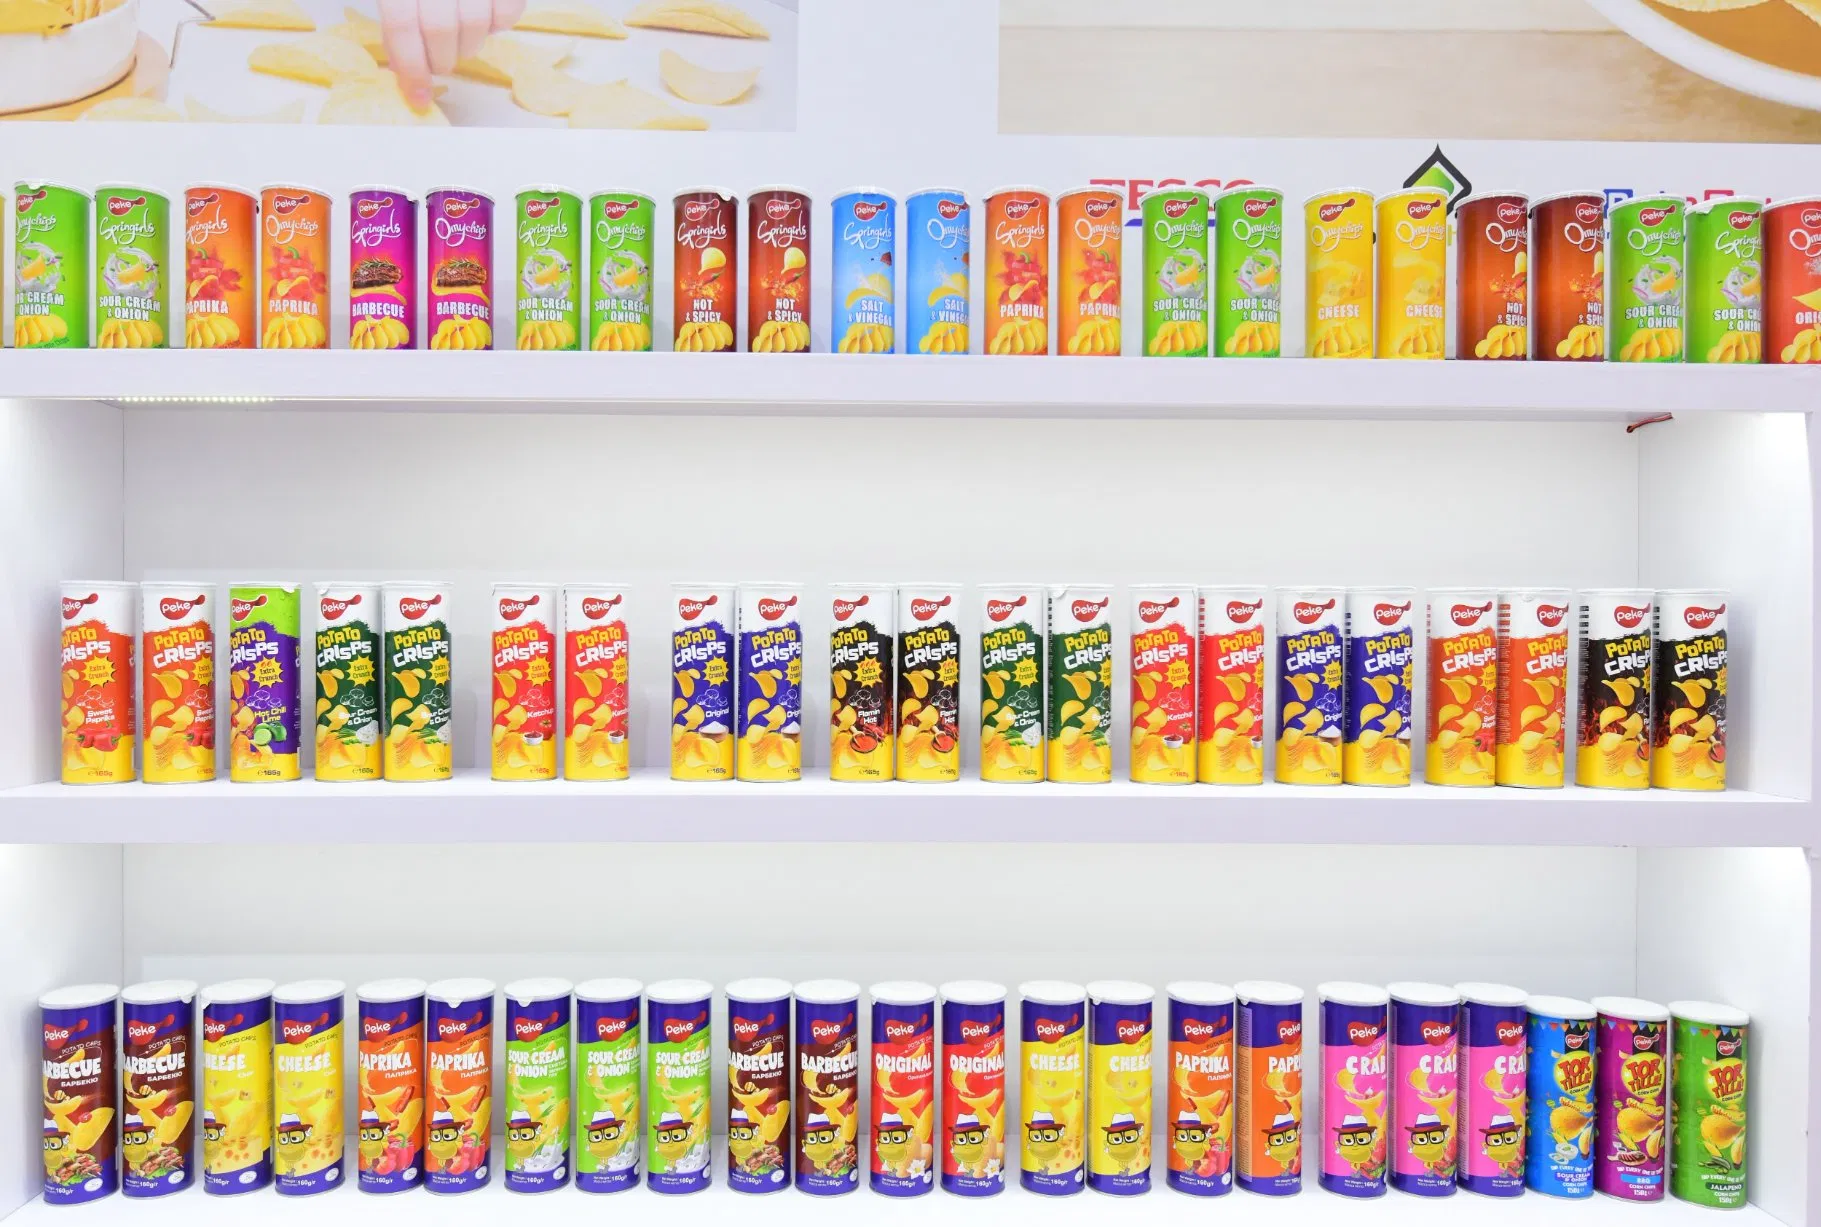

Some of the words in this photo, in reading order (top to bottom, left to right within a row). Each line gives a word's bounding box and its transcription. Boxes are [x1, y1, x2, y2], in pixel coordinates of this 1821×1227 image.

[28, 294, 64, 305] CREAM
[99, 296, 122, 308] SOUR
[125, 298, 161, 312] CREAM
[269, 299, 318, 314] PAPRIKA
[519, 299, 538, 310] SOUR
[542, 299, 573, 312] CREAM
[595, 299, 615, 311] SOUR
[619, 299, 649, 314] CREAM
[694, 299, 712, 310] HOT
[776, 299, 795, 310] HOT
[861, 299, 882, 312] SALT
[944, 299, 964, 311] SALT
[1154, 299, 1179, 311] SOUR
[1231, 299, 1256, 311] SOUR
[19, 305, 49, 316] ONION
[116, 308, 149, 321] ONION
[352, 304, 404, 318] BARBECUE
[437, 302, 489, 319] BARBECUE
[532, 311, 563, 321] ONION
[611, 311, 641, 323] ONION
[692, 311, 721, 323] SPICY
[775, 311, 802, 323] SPICY
[1001, 304, 1044, 318] PAPRIKA
[1173, 310, 1201, 323] ONION
[1251, 310, 1278, 323] ONION
[1318, 306, 1360, 318] CHEESE
[1507, 304, 1522, 314] HOT
[1626, 306, 1655, 319] SOUR
[1714, 310, 1741, 321] SOUR
[1647, 317, 1678, 329] ONION
[154, 628, 204, 648] POTATO
[318, 628, 361, 647] POTATO
[394, 627, 440, 648] POTATO
[495, 628, 538, 648] POTATO
[576, 628, 622, 648] POTATO
[674, 628, 716, 648] POTATO
[752, 628, 796, 648] POTATO
[905, 628, 950, 649] POTATO
[984, 629, 1026, 648] POTATO
[1064, 629, 1108, 650] POTATO
[1134, 630, 1178, 652] POTATO
[1287, 632, 1334, 654] POTATO
[1444, 634, 1492, 656] POTATO
[153, 640, 212, 668] CRISPS
[318, 640, 372, 667] CRISPS
[392, 640, 448, 668] CRISPS
[494, 640, 548, 667] CRISPS
[576, 640, 628, 666] CRISPS
[674, 642, 726, 667] CRISPS
[751, 642, 800, 668] CRISPS
[904, 642, 958, 668] CRISPS
[983, 642, 1036, 668] CRISPS
[1133, 644, 1188, 670] CRISPS
[1676, 638, 1724, 660] POTATO
[1286, 646, 1341, 672] CRISPS
[1442, 646, 1496, 674] CRISPS
[278, 1053, 331, 1071] CHEESE
[360, 1052, 411, 1071] PAPRIKA
[431, 1051, 485, 1071] PAPRIKA
[508, 1050, 531, 1063] SOUR
[532, 1050, 565, 1063] CREAM
[588, 1051, 612, 1064] SOUR
[656, 1051, 680, 1065] SOUR
[876, 1053, 931, 1073] ORIGINAL
[1030, 1054, 1080, 1071] CHEESE
[1176, 1052, 1229, 1073] PAPRIKA
[515, 1064, 548, 1078] ONION
[598, 1064, 629, 1078] ONION
[665, 1064, 697, 1078] ONION
